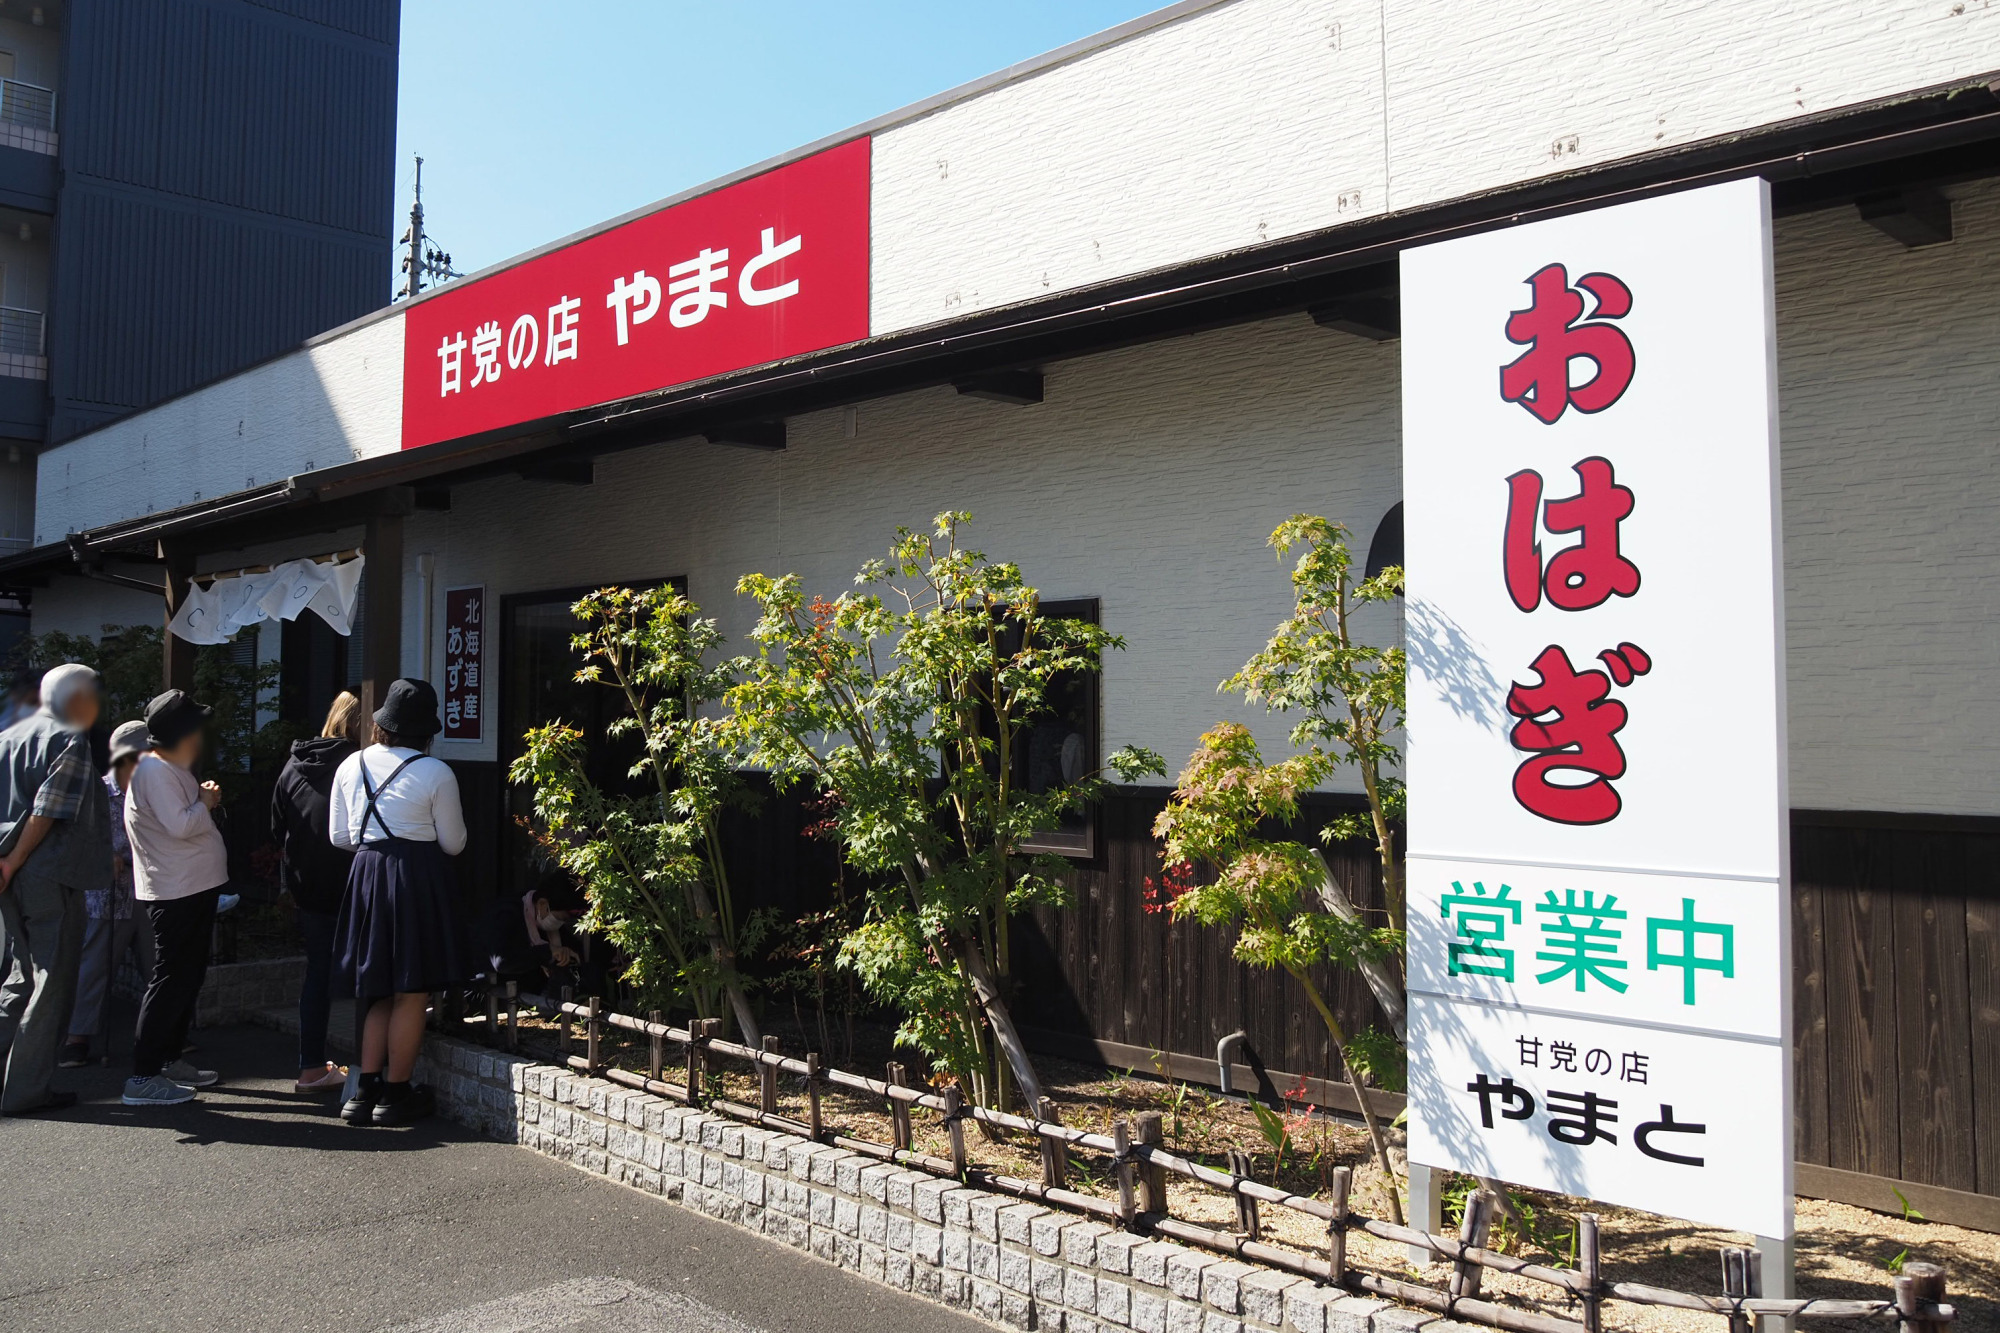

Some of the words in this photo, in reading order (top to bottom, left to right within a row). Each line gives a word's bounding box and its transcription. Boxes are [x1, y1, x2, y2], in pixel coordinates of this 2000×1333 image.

[437, 295, 581, 398] 甘党の店
[606, 226, 802, 346] やまと
[1499, 262, 1652, 826] おはぎ
[446, 625, 464, 729] あずき
[463, 598, 480, 719] 北海道産
[1440, 880, 1735, 1006] 営業中
[1515, 1034, 1650, 1085] 甘党の店
[1466, 1073, 1706, 1168] やまと
